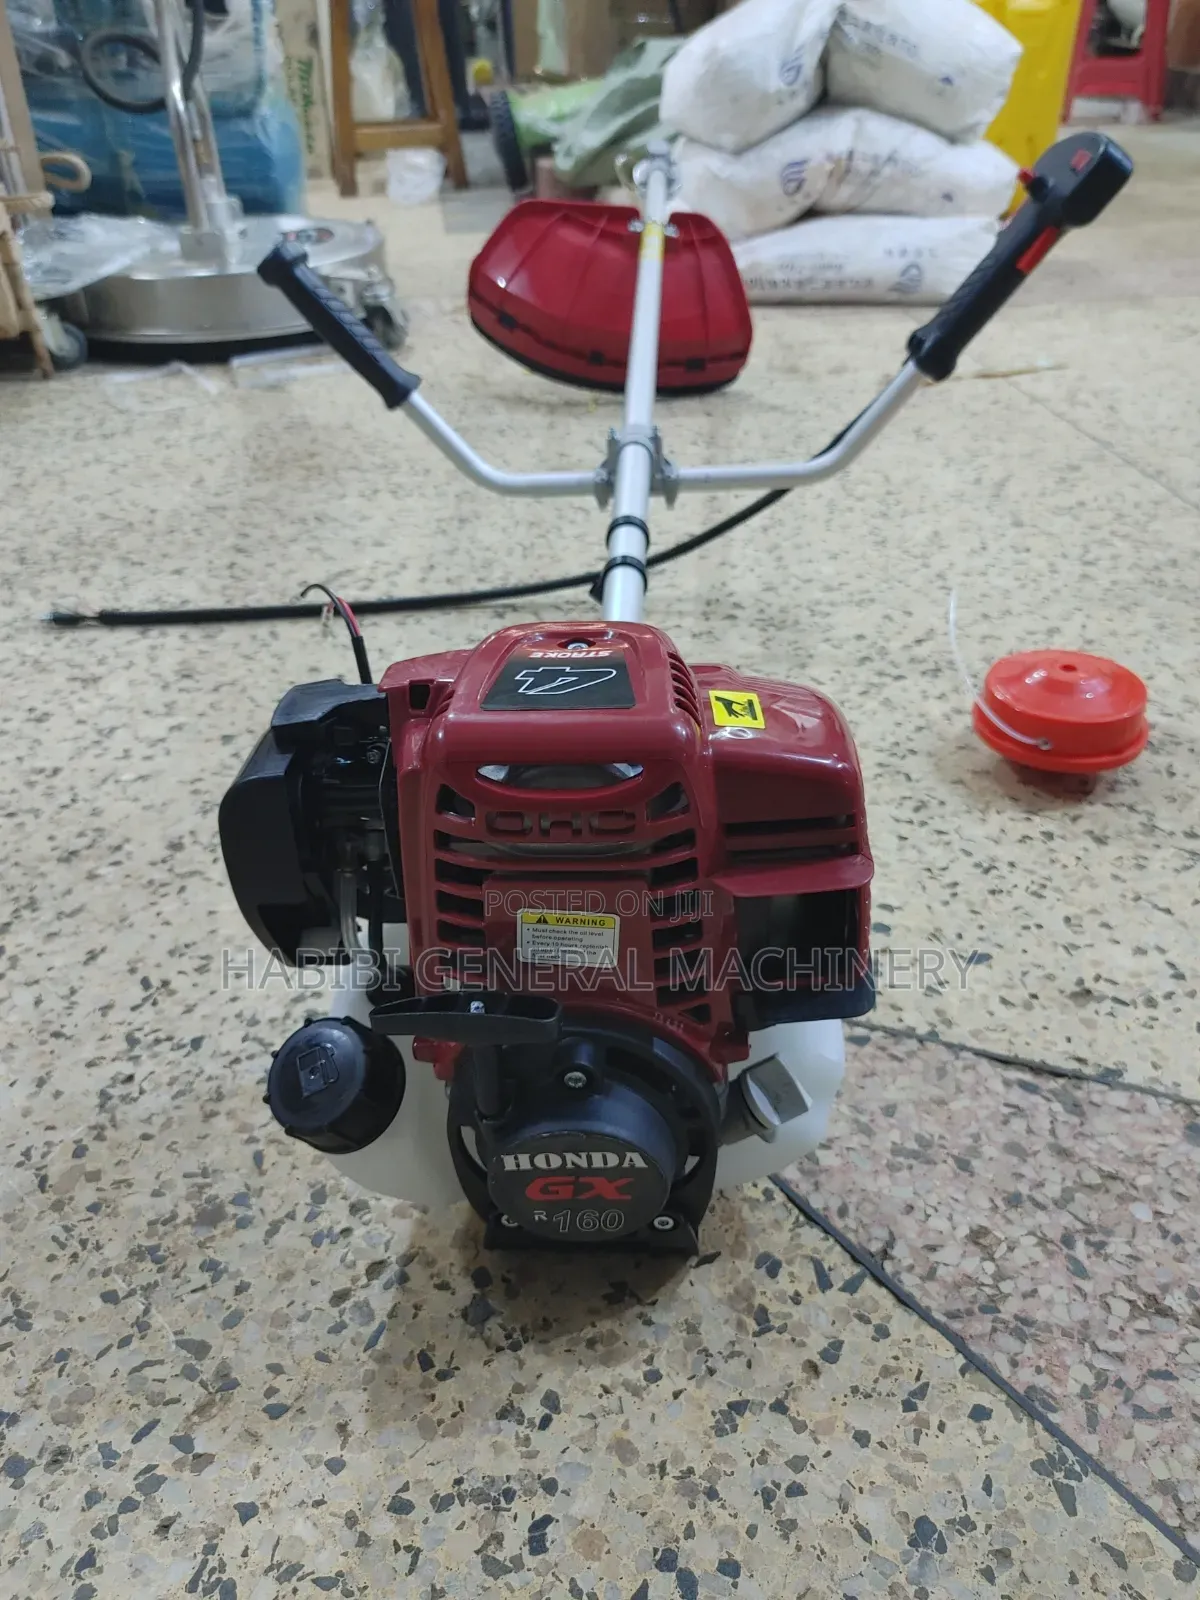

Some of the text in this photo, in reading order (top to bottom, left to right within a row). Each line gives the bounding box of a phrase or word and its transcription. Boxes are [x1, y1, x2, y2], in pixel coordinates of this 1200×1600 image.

[528, 650, 613, 658] STROKE
[514, 666, 617, 695] 4
[486, 811, 637, 837] OHC
[555, 916, 606, 927] WARNING
[501, 1151, 648, 1171] HONDA
[525, 1175, 634, 1202] GX
[552, 1209, 625, 1232] 160
